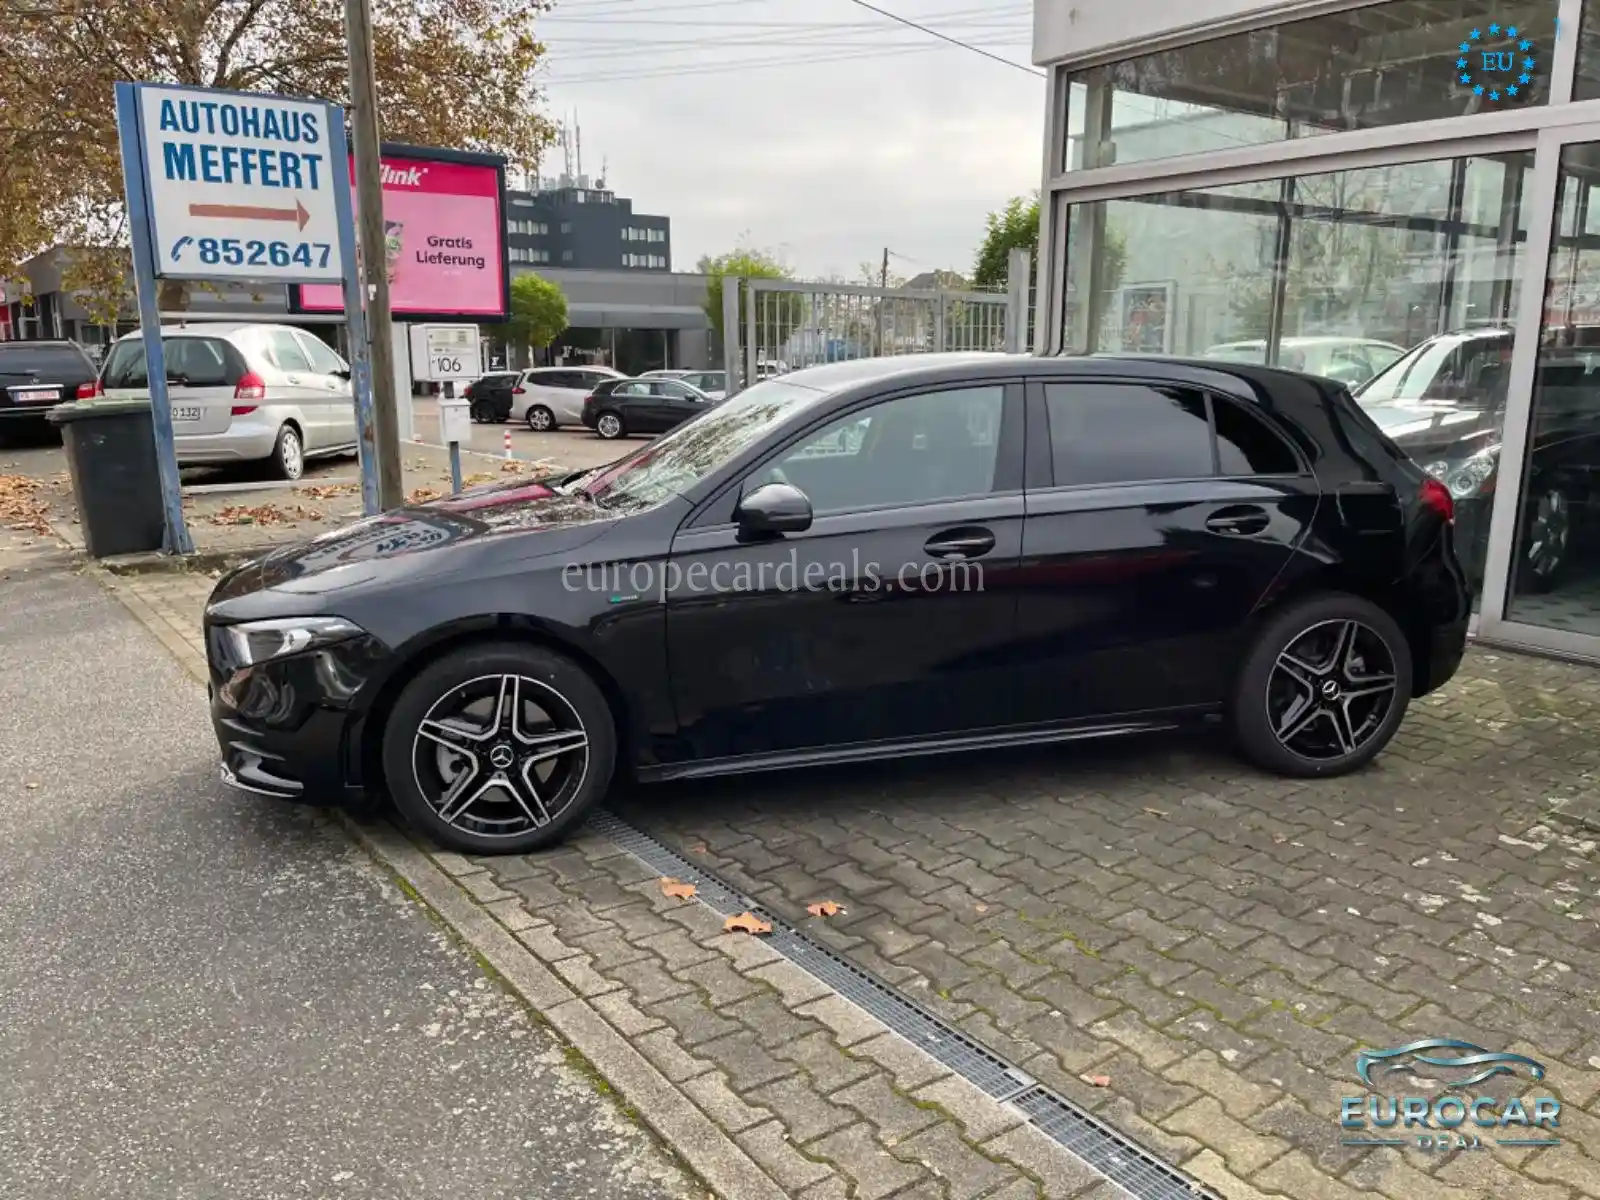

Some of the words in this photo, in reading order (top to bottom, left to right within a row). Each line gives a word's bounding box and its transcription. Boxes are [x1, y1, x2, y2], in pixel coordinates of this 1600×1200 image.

[160, 99, 319, 144] AUTOHAUS
[163, 142, 323, 190] MEFFERT
[198, 238, 331, 268] 852647
[427, 235, 473, 249] Gratis
[416, 251, 485, 269] Lieferung
[437, 357, 462, 373] 106
